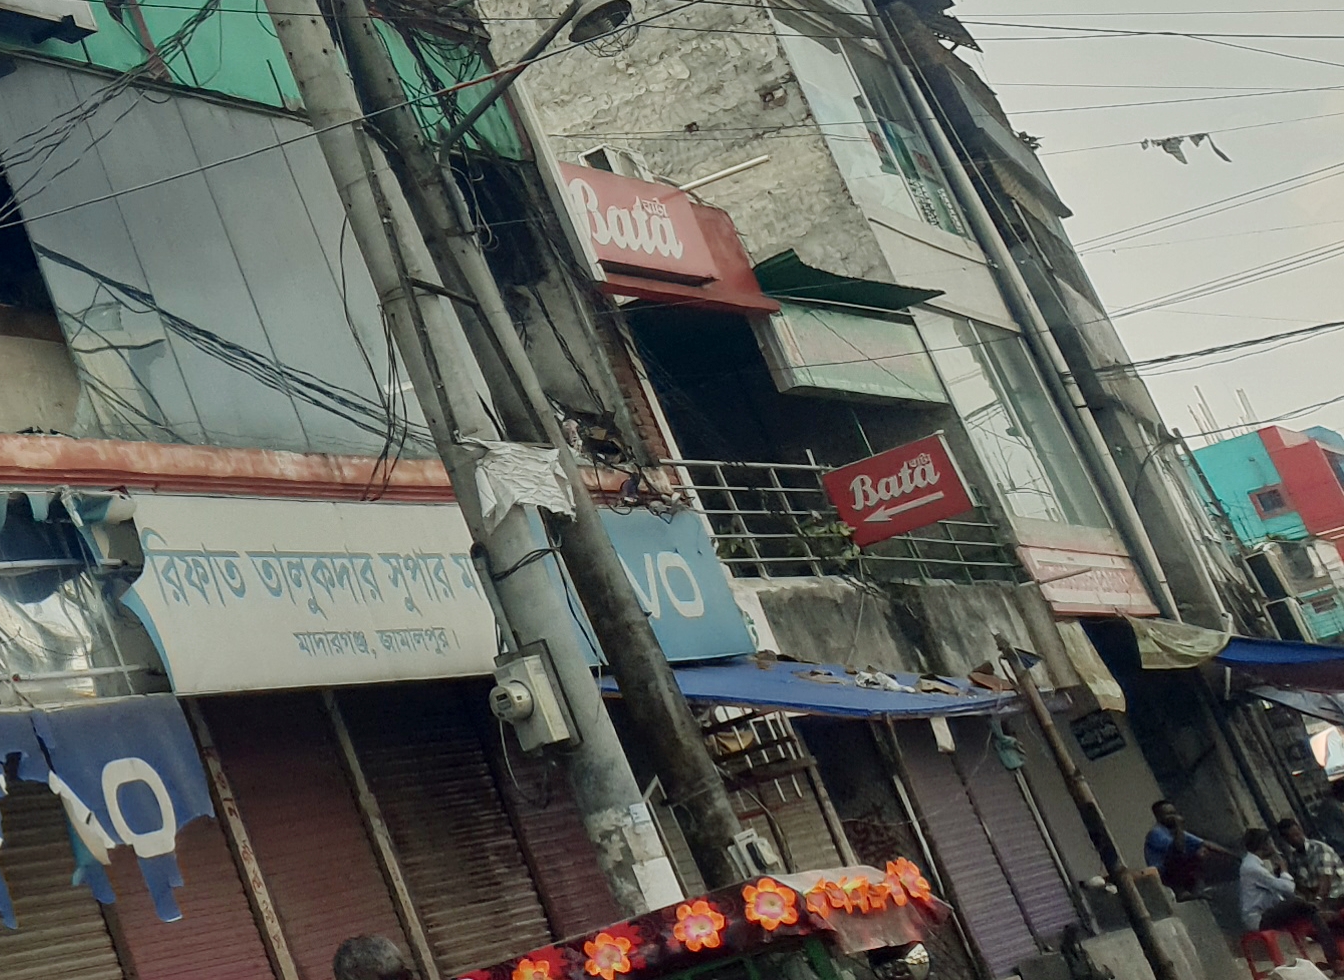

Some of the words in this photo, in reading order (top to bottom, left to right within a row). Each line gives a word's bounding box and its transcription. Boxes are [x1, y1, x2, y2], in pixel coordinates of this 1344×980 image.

[568, 177, 684, 260] Bata
[849, 461, 940, 511] Bata
[141, 527, 246, 608] রিফাত
[245, 544, 384, 620] তালুকদার
[378, 548, 455, 617] সুপার
